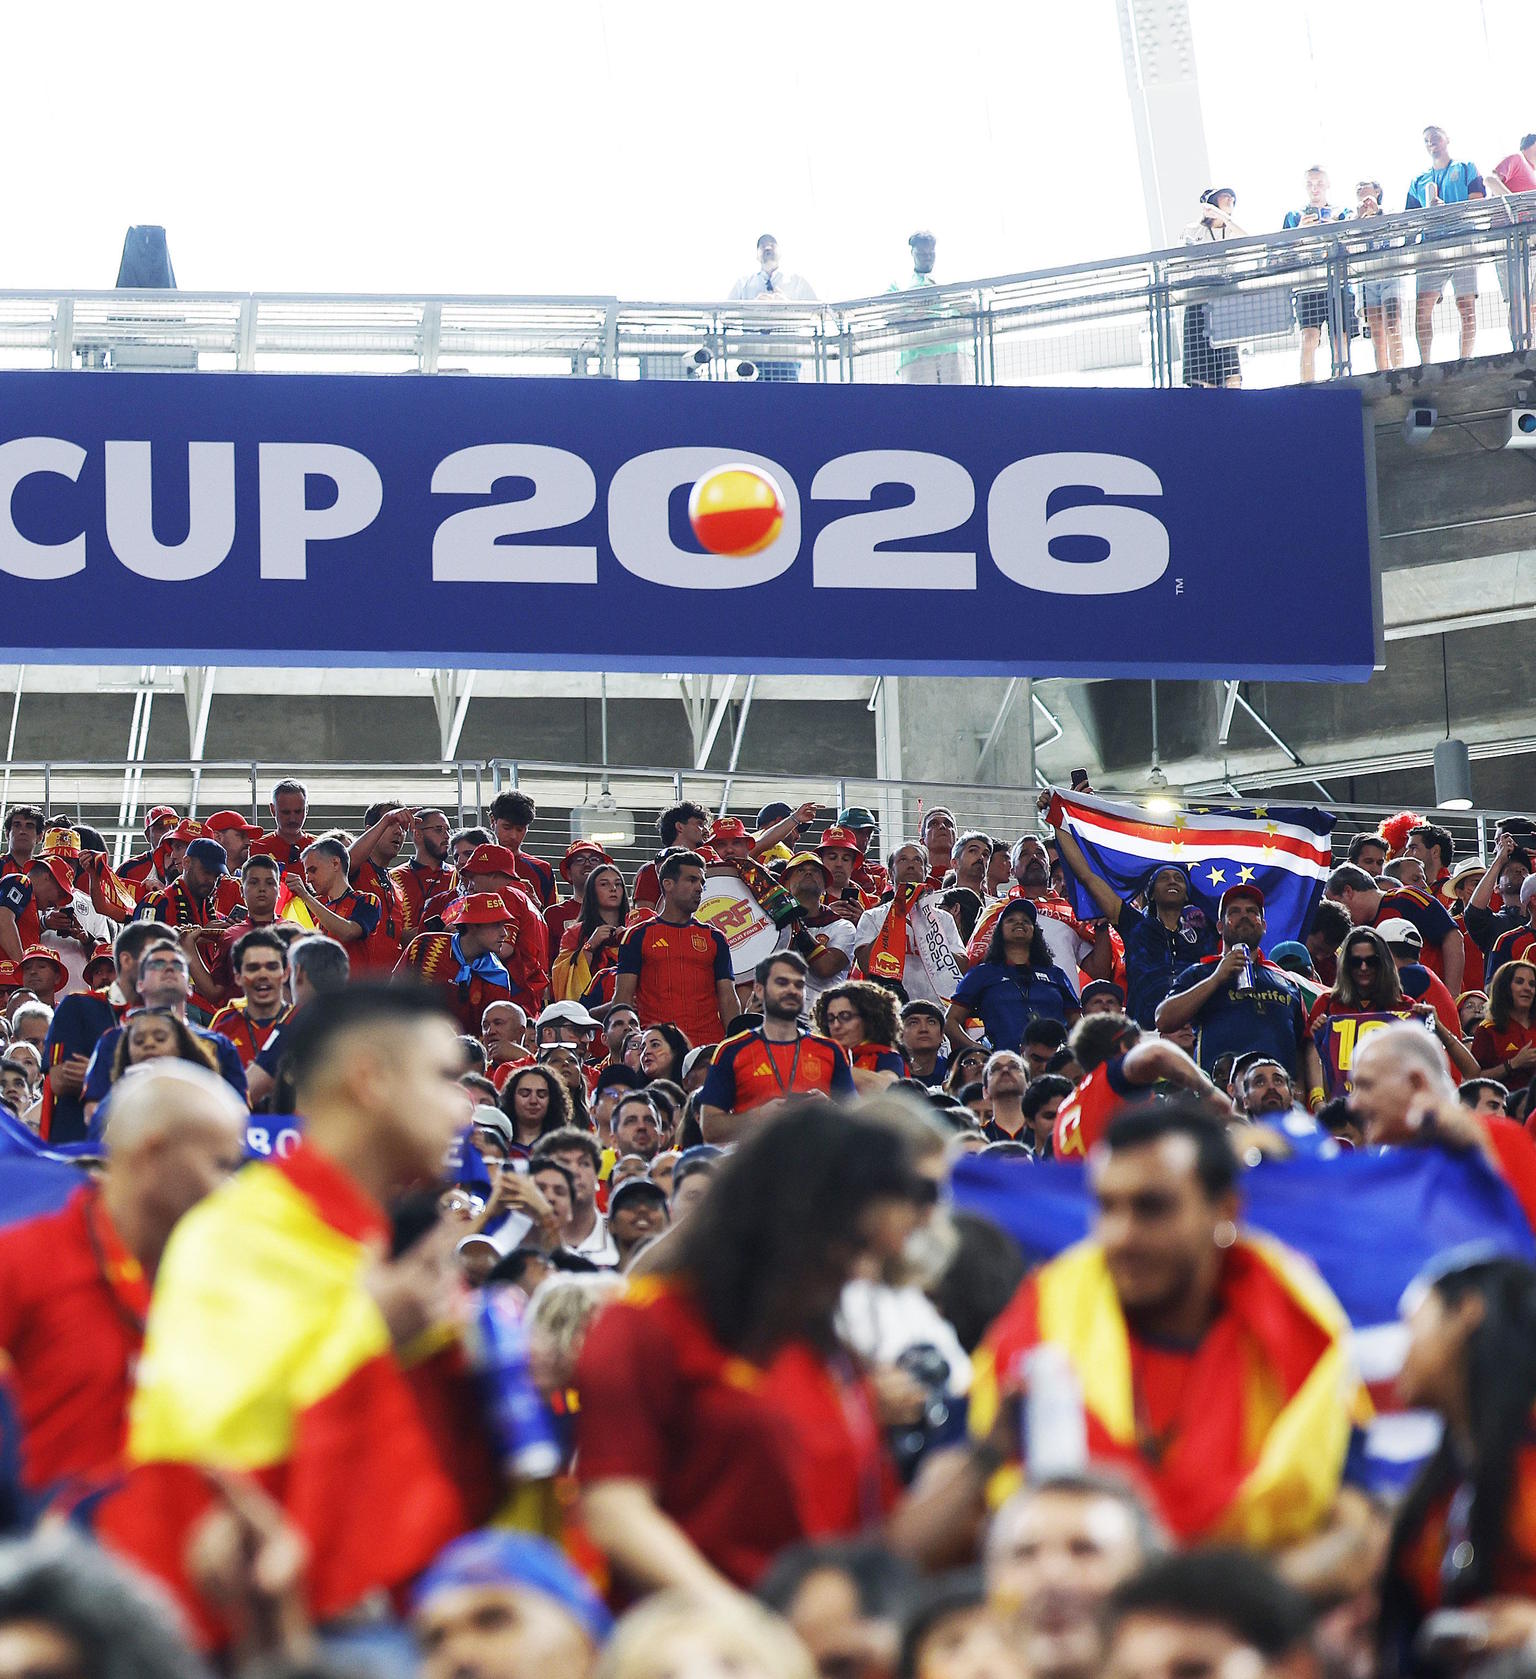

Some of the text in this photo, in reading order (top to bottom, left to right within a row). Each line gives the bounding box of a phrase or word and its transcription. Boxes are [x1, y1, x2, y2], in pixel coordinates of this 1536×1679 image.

[431, 444, 1169, 594] 2026
[705, 899, 752, 934] RF
[925, 931, 945, 972] 2024
